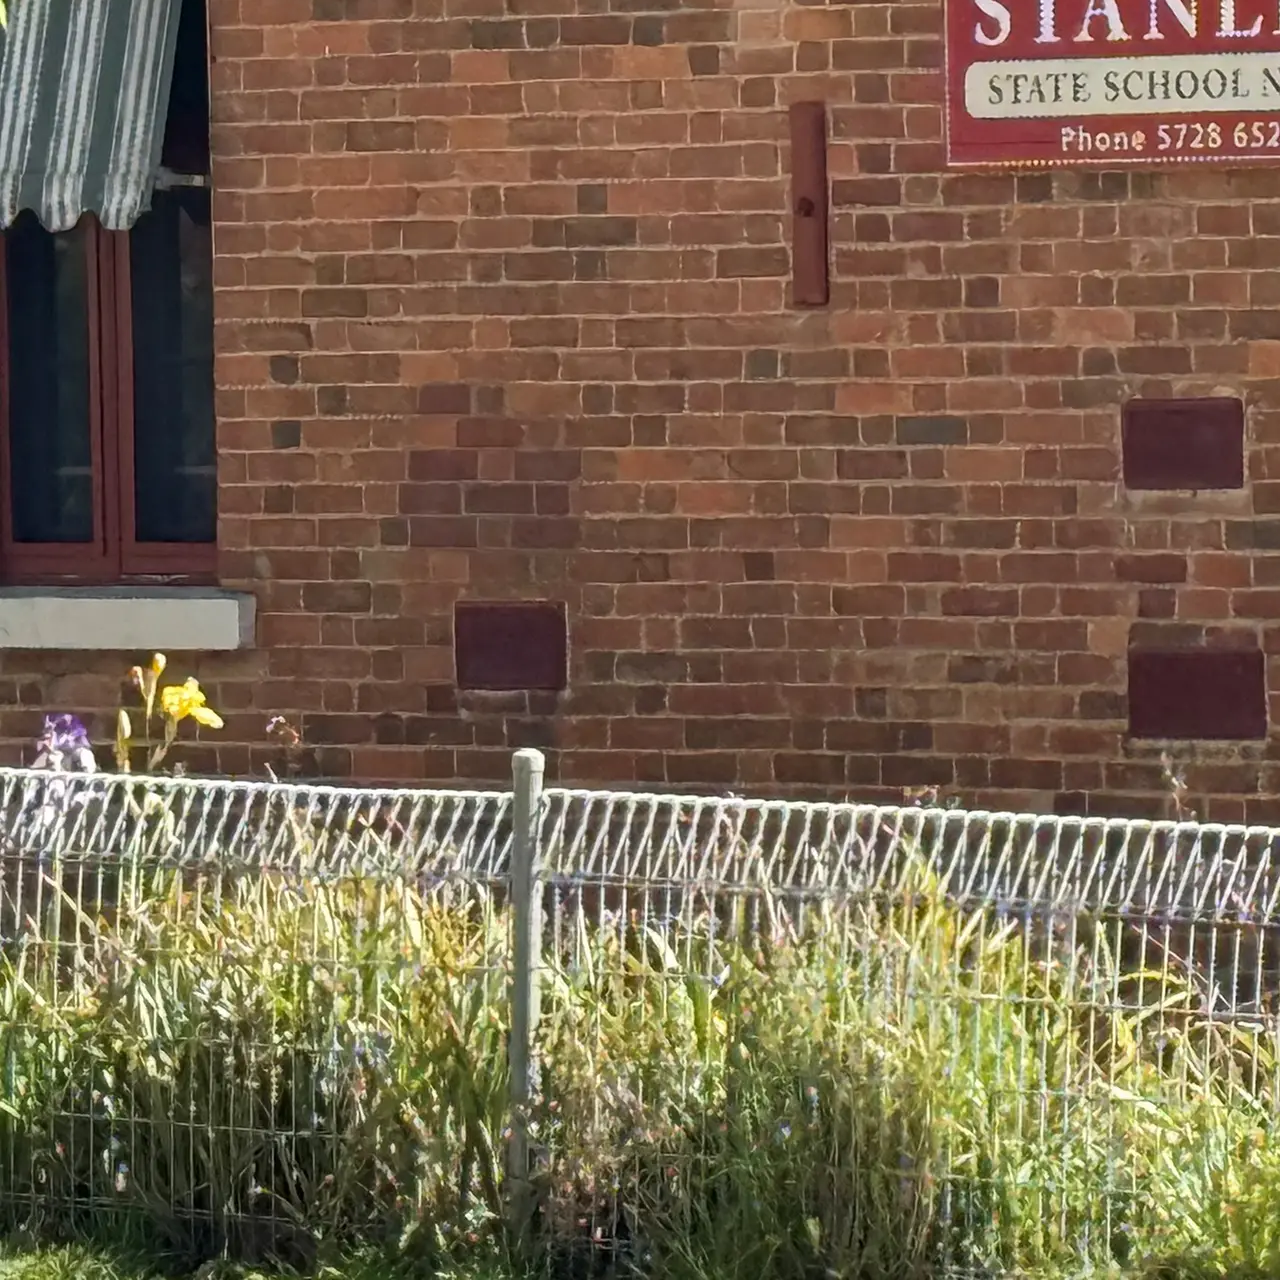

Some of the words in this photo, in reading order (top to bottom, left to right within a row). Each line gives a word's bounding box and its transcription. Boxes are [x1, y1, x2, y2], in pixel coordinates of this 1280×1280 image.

[987, 70, 1091, 105] STATE
[1103, 67, 1250, 103] SCHOOL
[1060, 125, 1147, 152] Phone
[1157, 121, 1222, 150] 5728
